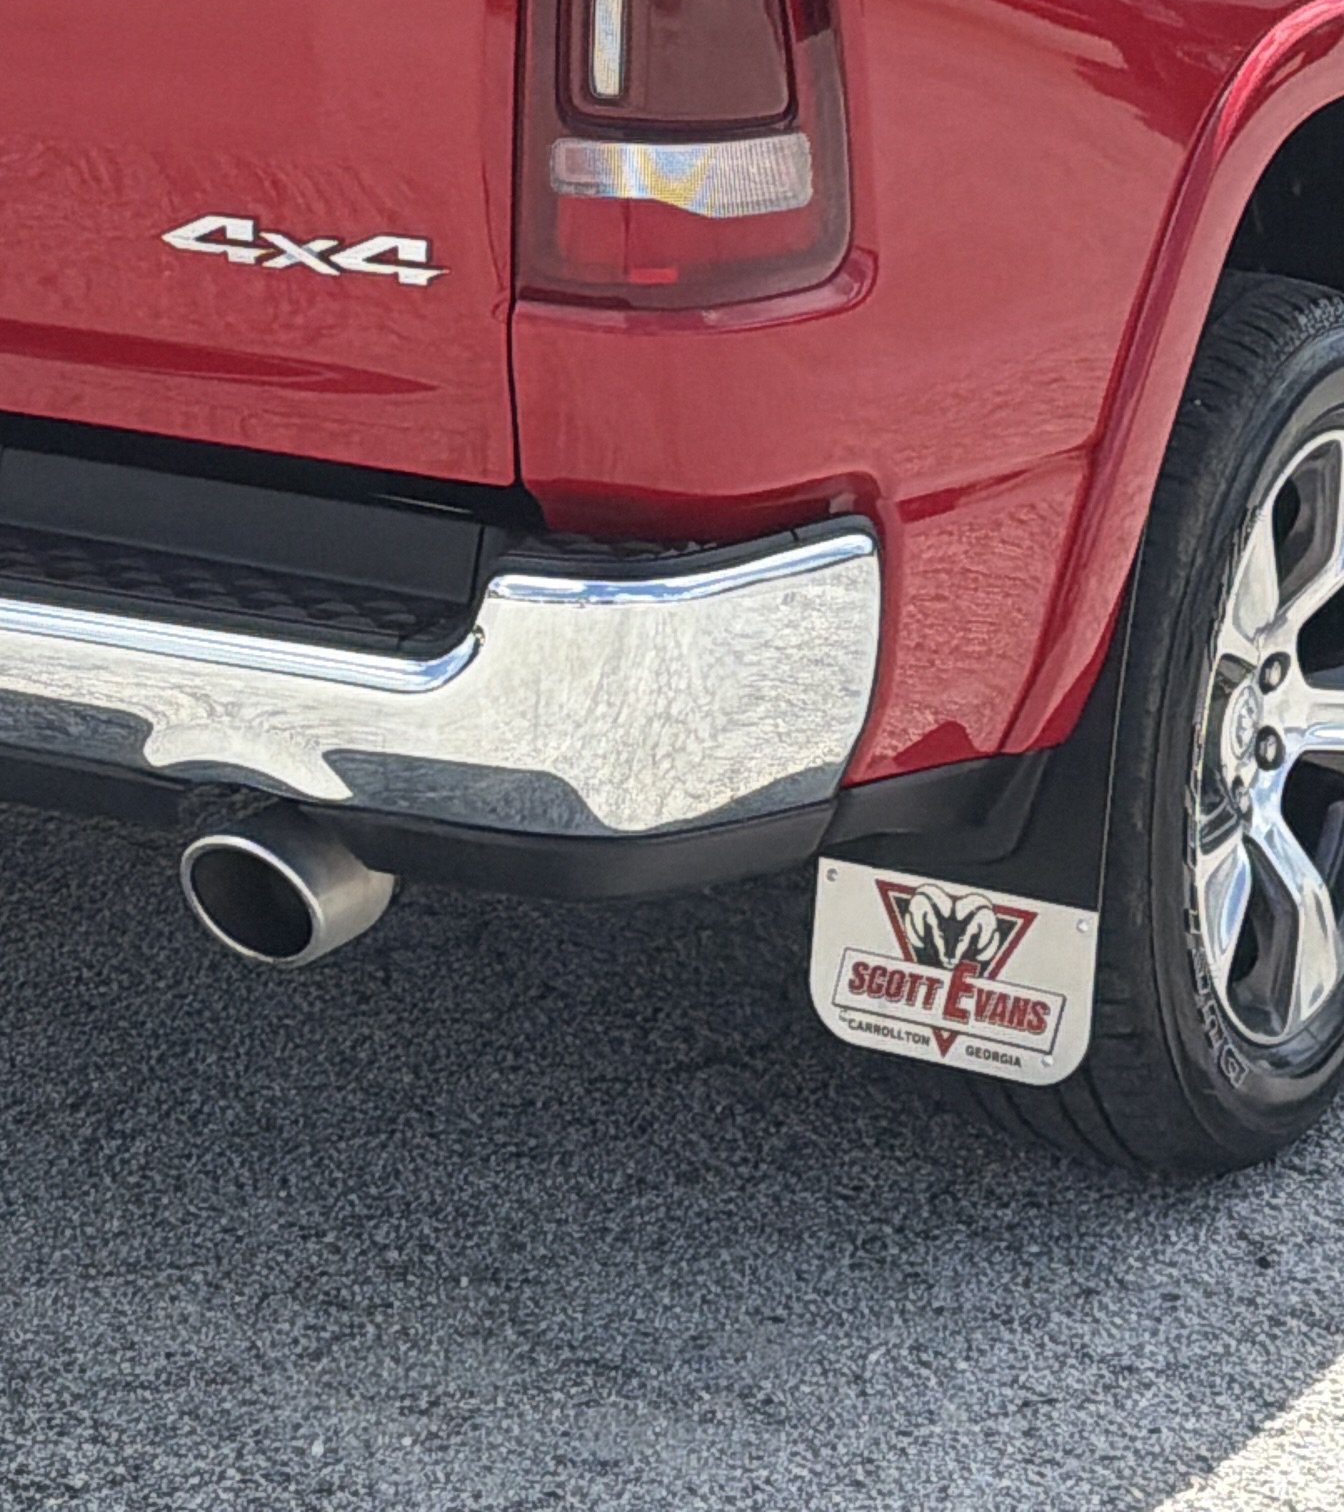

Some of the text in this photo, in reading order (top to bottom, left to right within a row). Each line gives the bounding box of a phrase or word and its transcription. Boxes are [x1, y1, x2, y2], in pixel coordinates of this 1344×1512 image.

[847, 959, 1051, 1035] SCOTT EVANS
[847, 1018, 931, 1047] CARROLLTON
[965, 1044, 1023, 1069] GEORGIA
